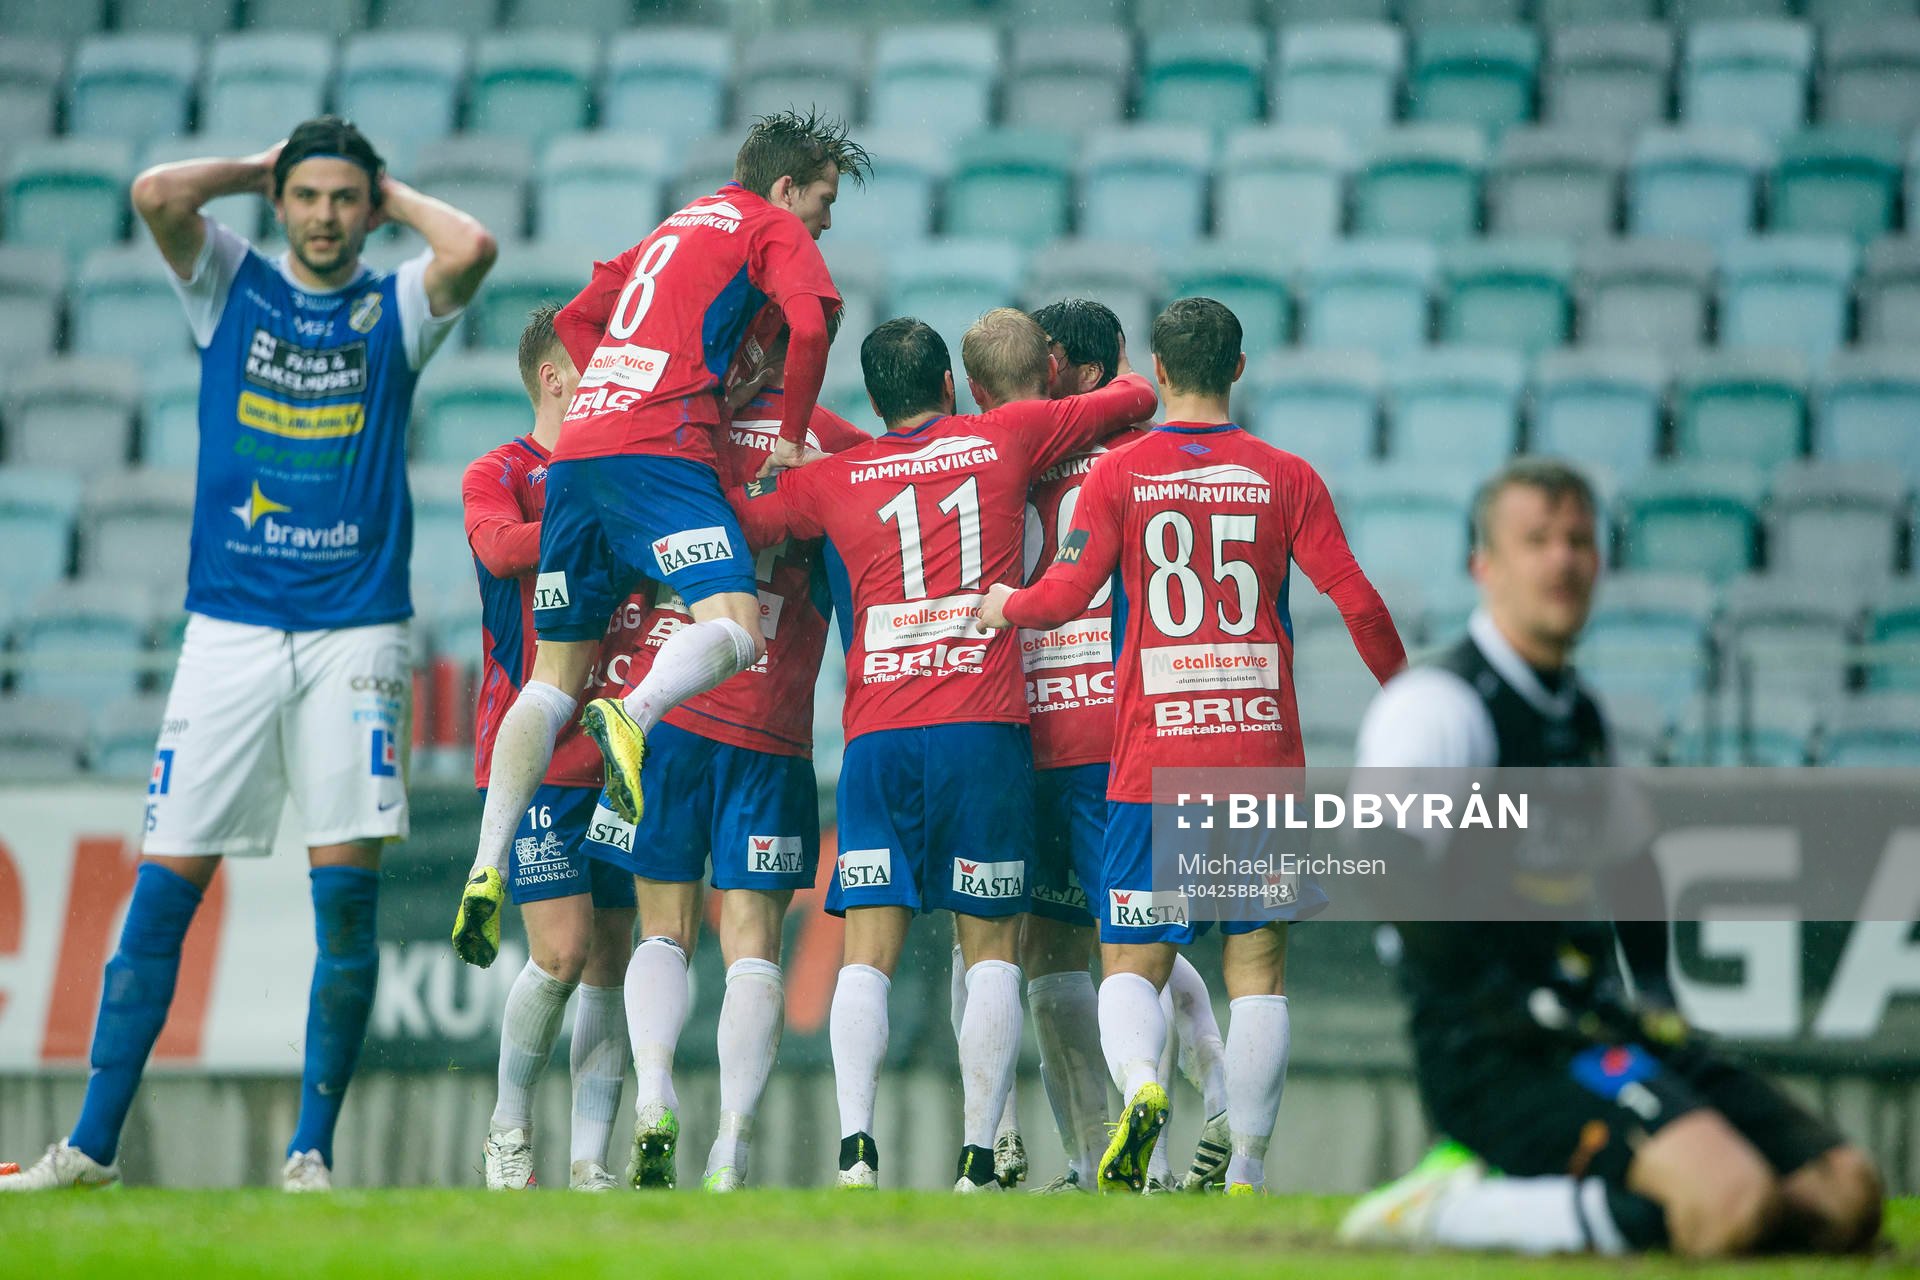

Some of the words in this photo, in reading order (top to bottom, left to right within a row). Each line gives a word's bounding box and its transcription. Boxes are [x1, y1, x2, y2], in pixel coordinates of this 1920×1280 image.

[660, 215, 740, 234] MARVIKEN
[608, 234, 680, 340] 8
[850, 447, 998, 484] HAMMARVIKEN
[1133, 484, 1270, 504] HAMMARVIKEN
[264, 516, 359, 549] bravida
[876, 473, 984, 600] 11
[661, 541, 730, 572] RASTA
[1144, 510, 1260, 638] 85
[1023, 630, 1112, 652] etallservic
[864, 644, 987, 676] BRIG
[1154, 696, 1281, 727] BRIG
[1156, 723, 1237, 737] inflatable
[1240, 721, 1283, 733] boats
[527, 804, 552, 830] 16
[518, 861, 570, 876] STIFTELSEN
[958, 873, 1024, 898] RASTA
[1116, 904, 1187, 928] RASTA
